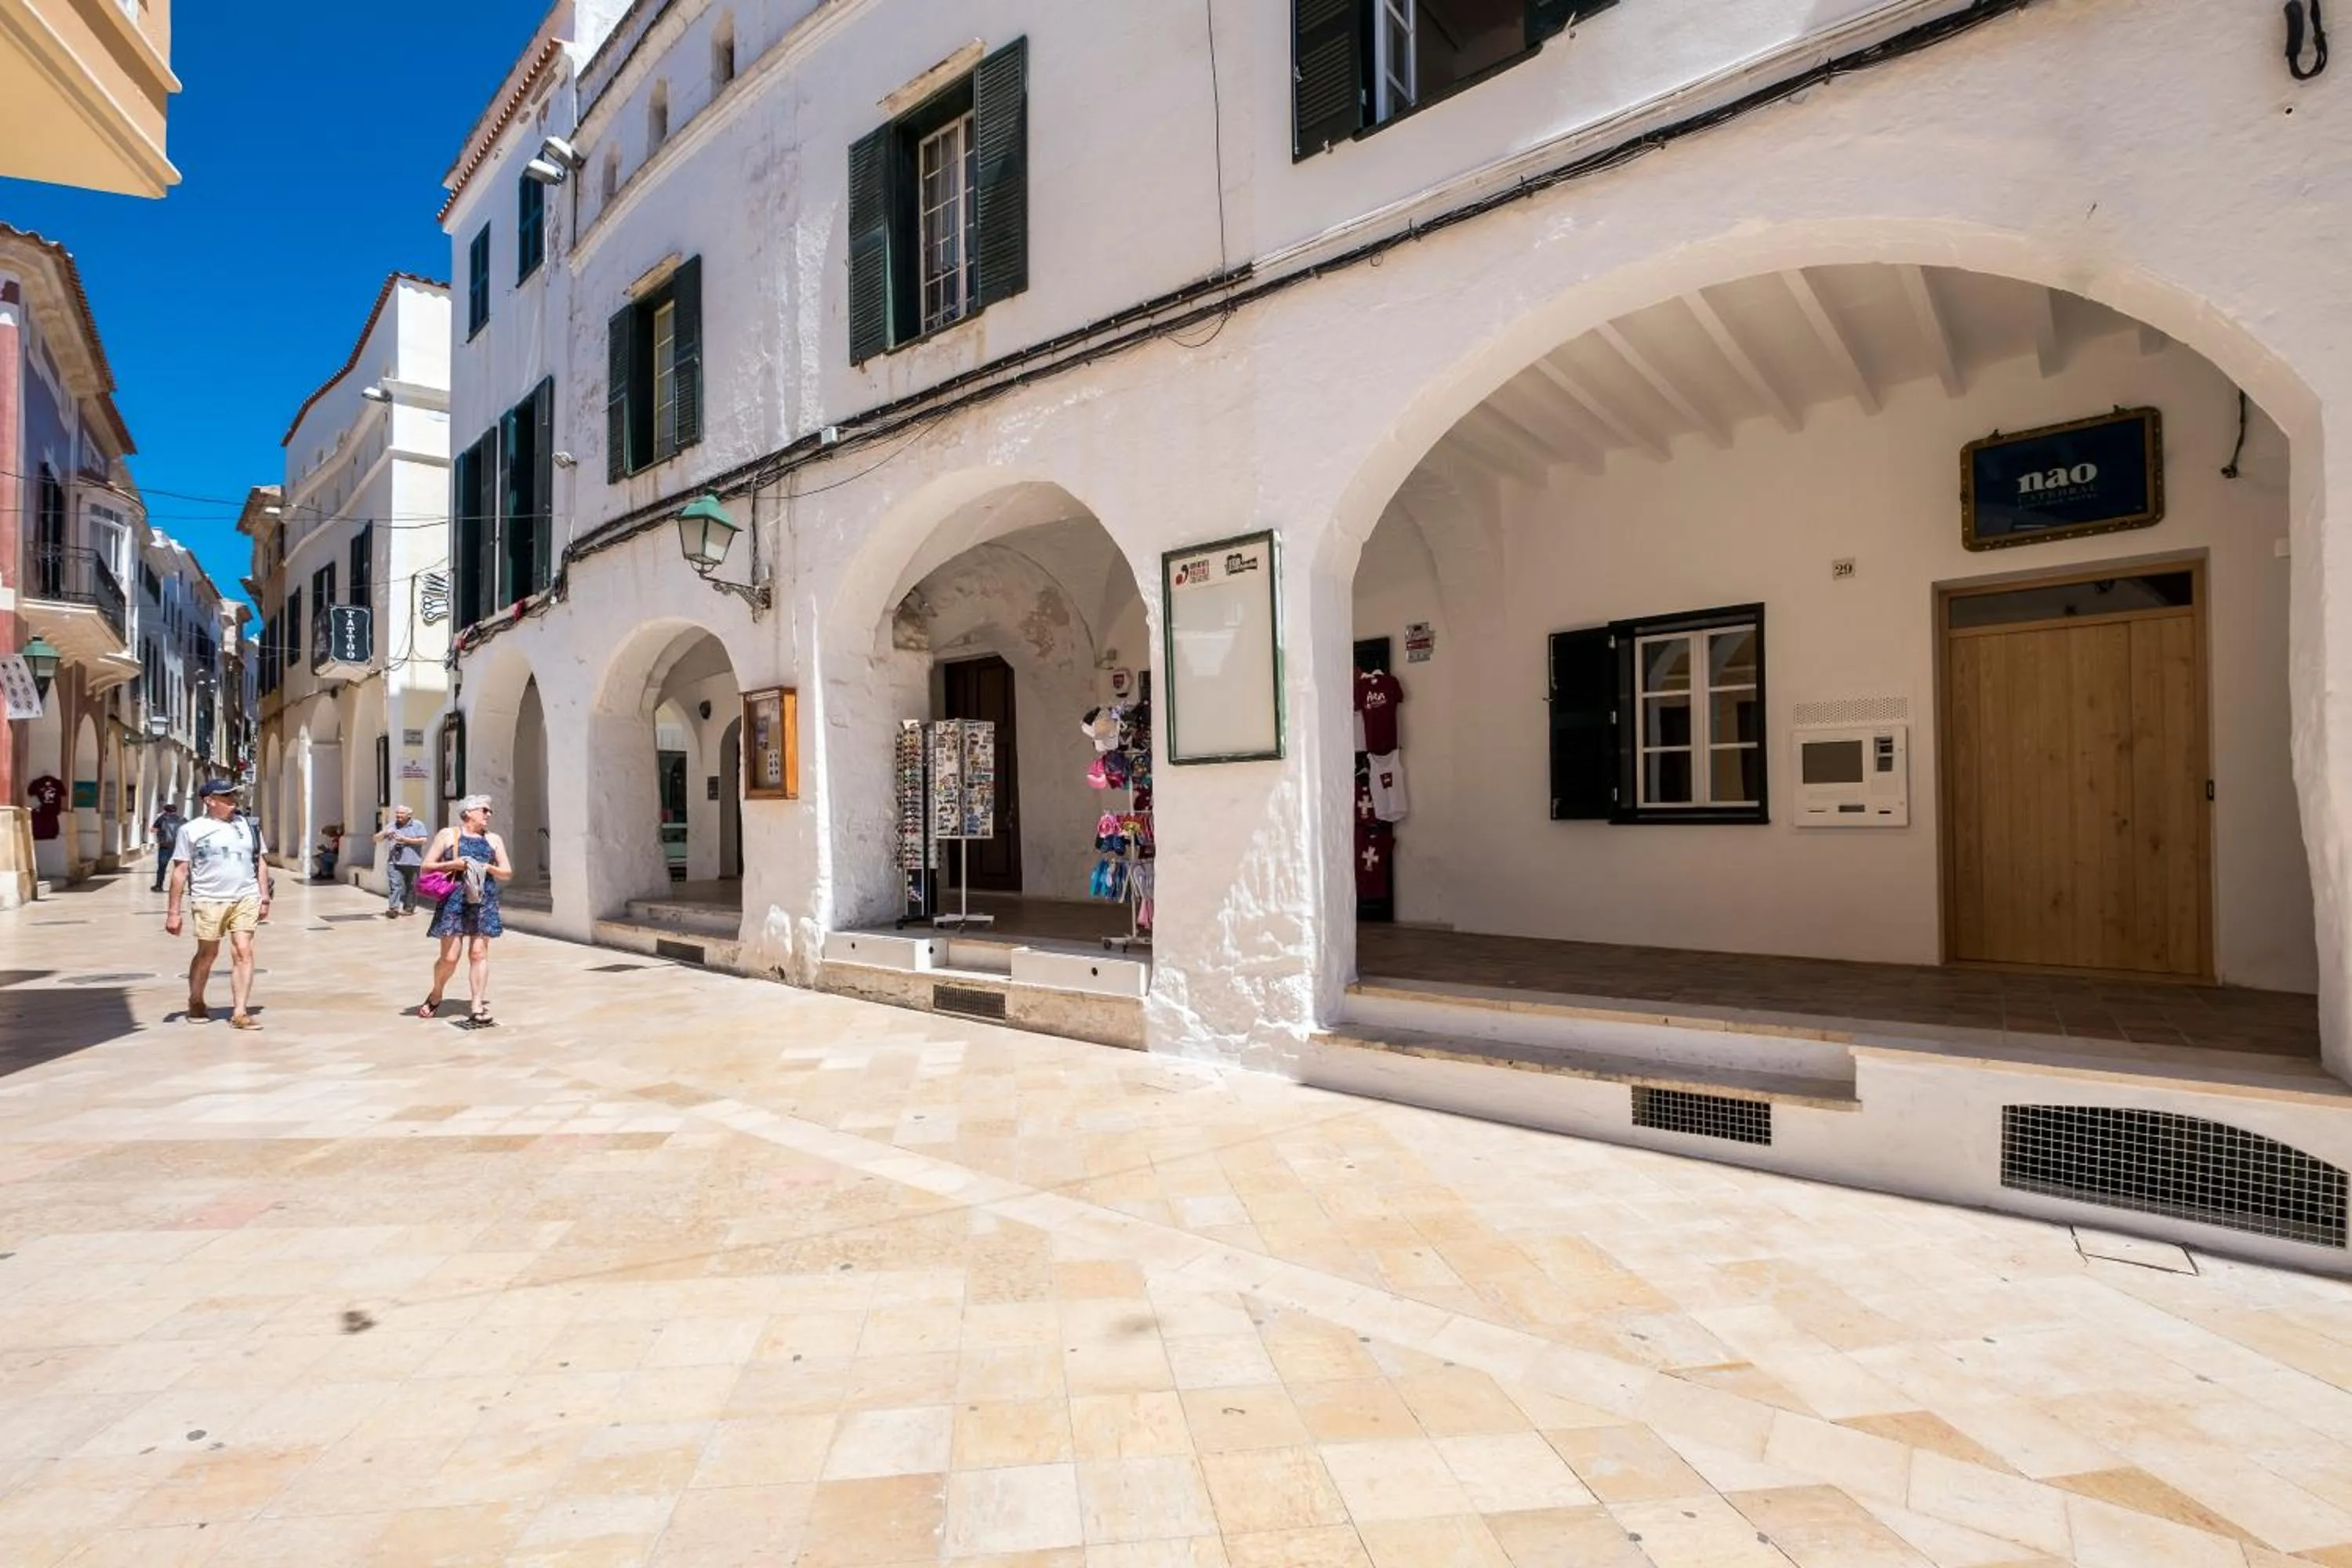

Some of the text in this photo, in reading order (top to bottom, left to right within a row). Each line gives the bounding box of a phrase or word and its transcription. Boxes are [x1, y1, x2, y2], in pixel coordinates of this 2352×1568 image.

[2016, 463, 2098, 493] nao
[1835, 563, 1853, 576] 29
[346, 610, 355, 659] TATTOO
